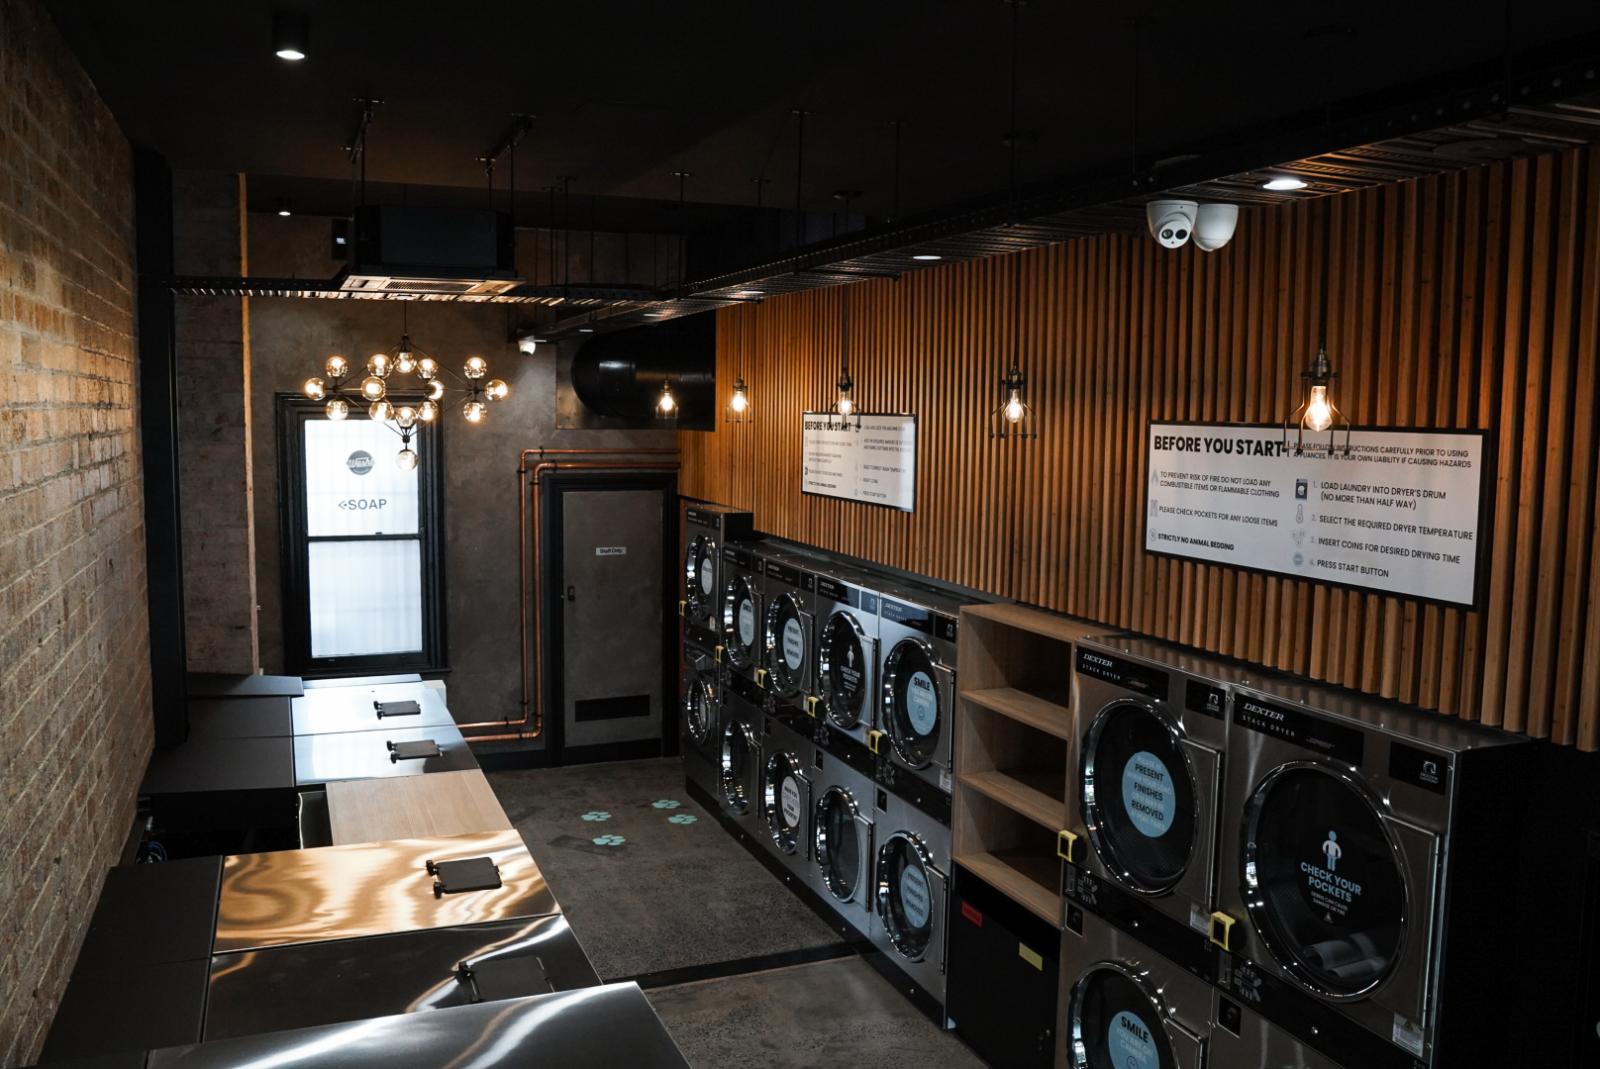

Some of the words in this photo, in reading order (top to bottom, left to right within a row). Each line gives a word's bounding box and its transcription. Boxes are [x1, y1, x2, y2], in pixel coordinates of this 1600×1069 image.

[805, 421, 822, 430] BEFORE
[1154, 436, 1200, 452] BEFORE
[1204, 438, 1233, 454] YOU
[1236, 439, 1283, 457] START
[1337, 444, 1378, 453] INSRUCTIONS
[1408, 458, 1438, 466] CAUSING
[1440, 460, 1472, 468] HAZARDS
[1160, 480, 1192, 489] COMBUSTIBLE
[1219, 486, 1249, 495] FLAMMABLE
[1250, 488, 1279, 498] CLOTHING
[1321, 482, 1338, 490] LOAD
[1340, 483, 1370, 493] LAUNDRY
[1373, 486, 1390, 494] INTO
[1391, 487, 1421, 498] DRYER'S
[1423, 490, 1446, 499] DRUM
[348, 499, 387, 510] SOAP
[1320, 492, 1334, 502] (NO
[1335, 494, 1354, 503] MORE
[1356, 496, 1375, 504] THAN
[1396, 500, 1417, 510] WAY)
[1194, 510, 1217, 519] POCKETS
[1242, 515, 1260, 525] LOOSE
[1261, 518, 1278, 527] ITEMS
[1319, 515, 1342, 525] SELECT
[1344, 518, 1356, 526] THE
[1358, 520, 1392, 530] REQUIRED
[1393, 524, 1416, 534] DRYER
[1419, 526, 1473, 540] TEMPERATURE
[1158, 533, 1180, 542] STRICTLY
[1190, 538, 1209, 547] ANIMAL
[1210, 542, 1234, 550] BEDDING
[1318, 537, 1340, 547] INSERT
[1341, 540, 1363, 550] COINS
[1365, 543, 1378, 552] FOR
[1380, 545, 1410, 557] DESIRED
[1412, 550, 1440, 561] DRYING
[1442, 553, 1460, 563] TIME
[1317, 559, 1337, 569] PRESS
[1338, 563, 1359, 572] START
[1360, 566, 1389, 577] BUTTON
[1083, 653, 1112, 668] DEXTER
[914, 676, 930, 691] SMILE
[1244, 702, 1284, 721] DEXTER
[1135, 763, 1164, 781] PRESENT
[1134, 782, 1163, 801] FINISHES
[1131, 800, 1164, 821] REMOVED
[1300, 862, 1333, 883] CHECK
[1334, 875, 1362, 896] YOUR
[1308, 876, 1352, 903] POCKETS
[1121, 1016, 1149, 1043] SMILE
